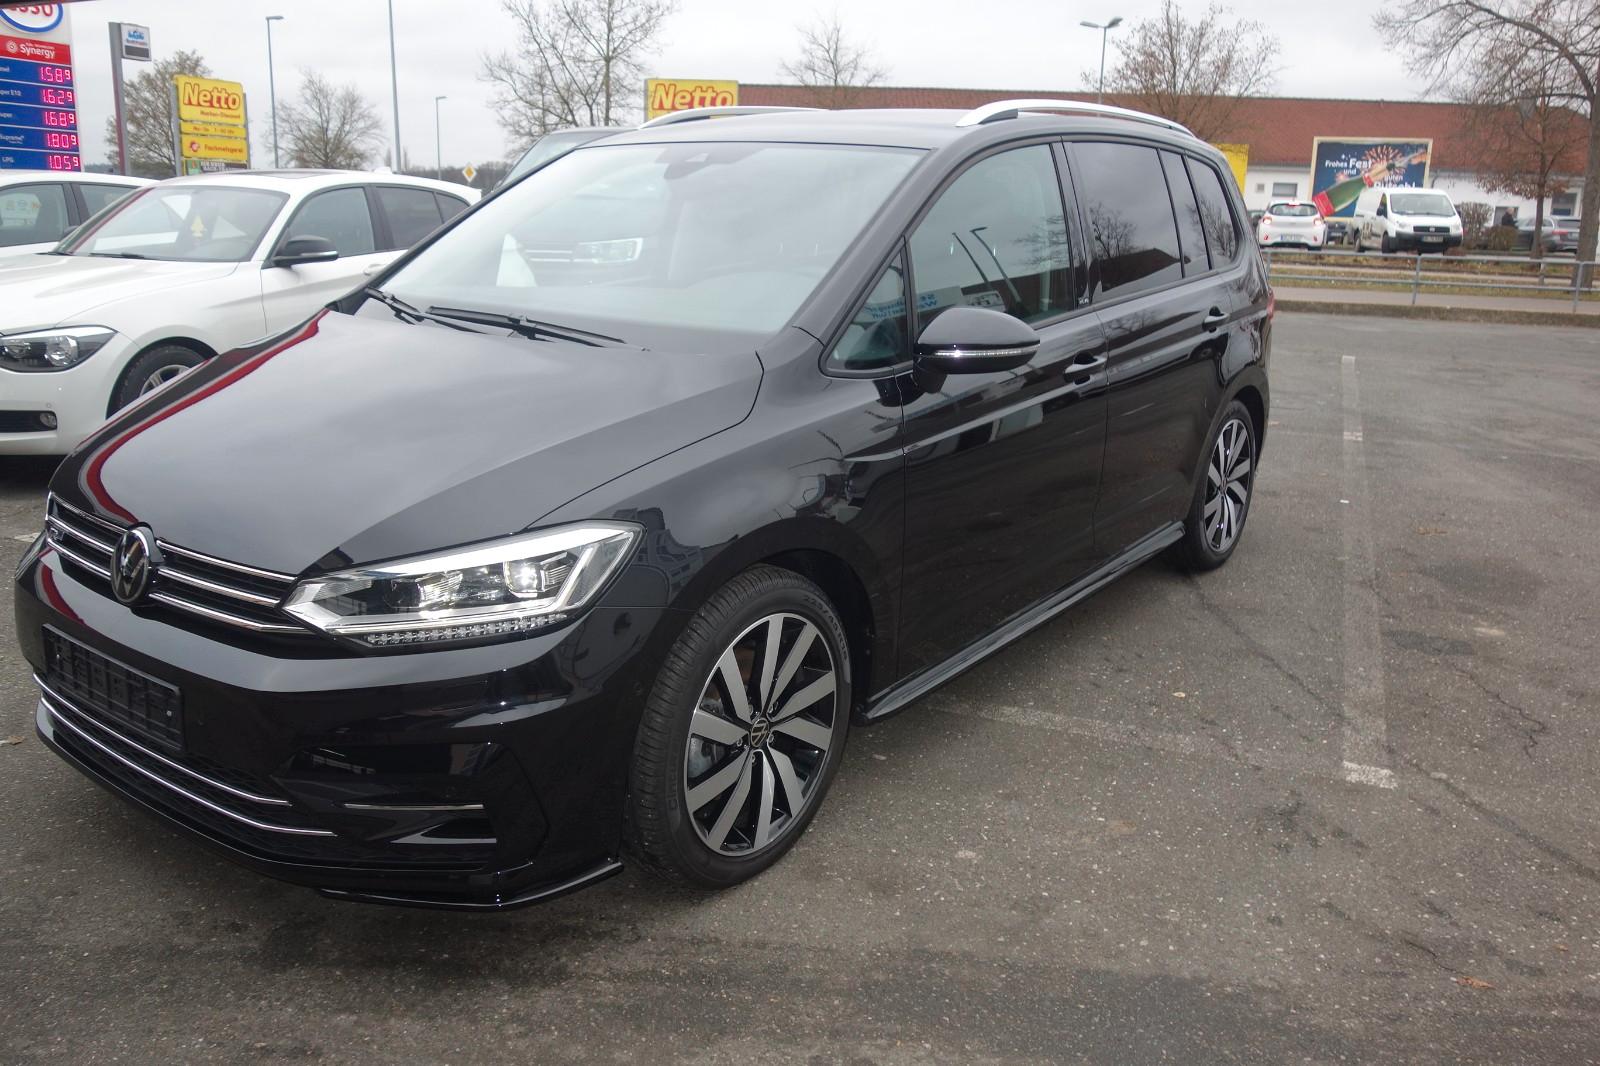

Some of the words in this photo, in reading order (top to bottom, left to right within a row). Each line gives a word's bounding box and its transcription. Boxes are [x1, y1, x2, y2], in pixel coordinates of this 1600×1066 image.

[19, 43, 55, 59] Synergy
[183, 82, 240, 110] Netto
[652, 83, 734, 110] Netto
[1325, 159, 1347, 169] Frohes
[1349, 157, 1372, 169] Fest
